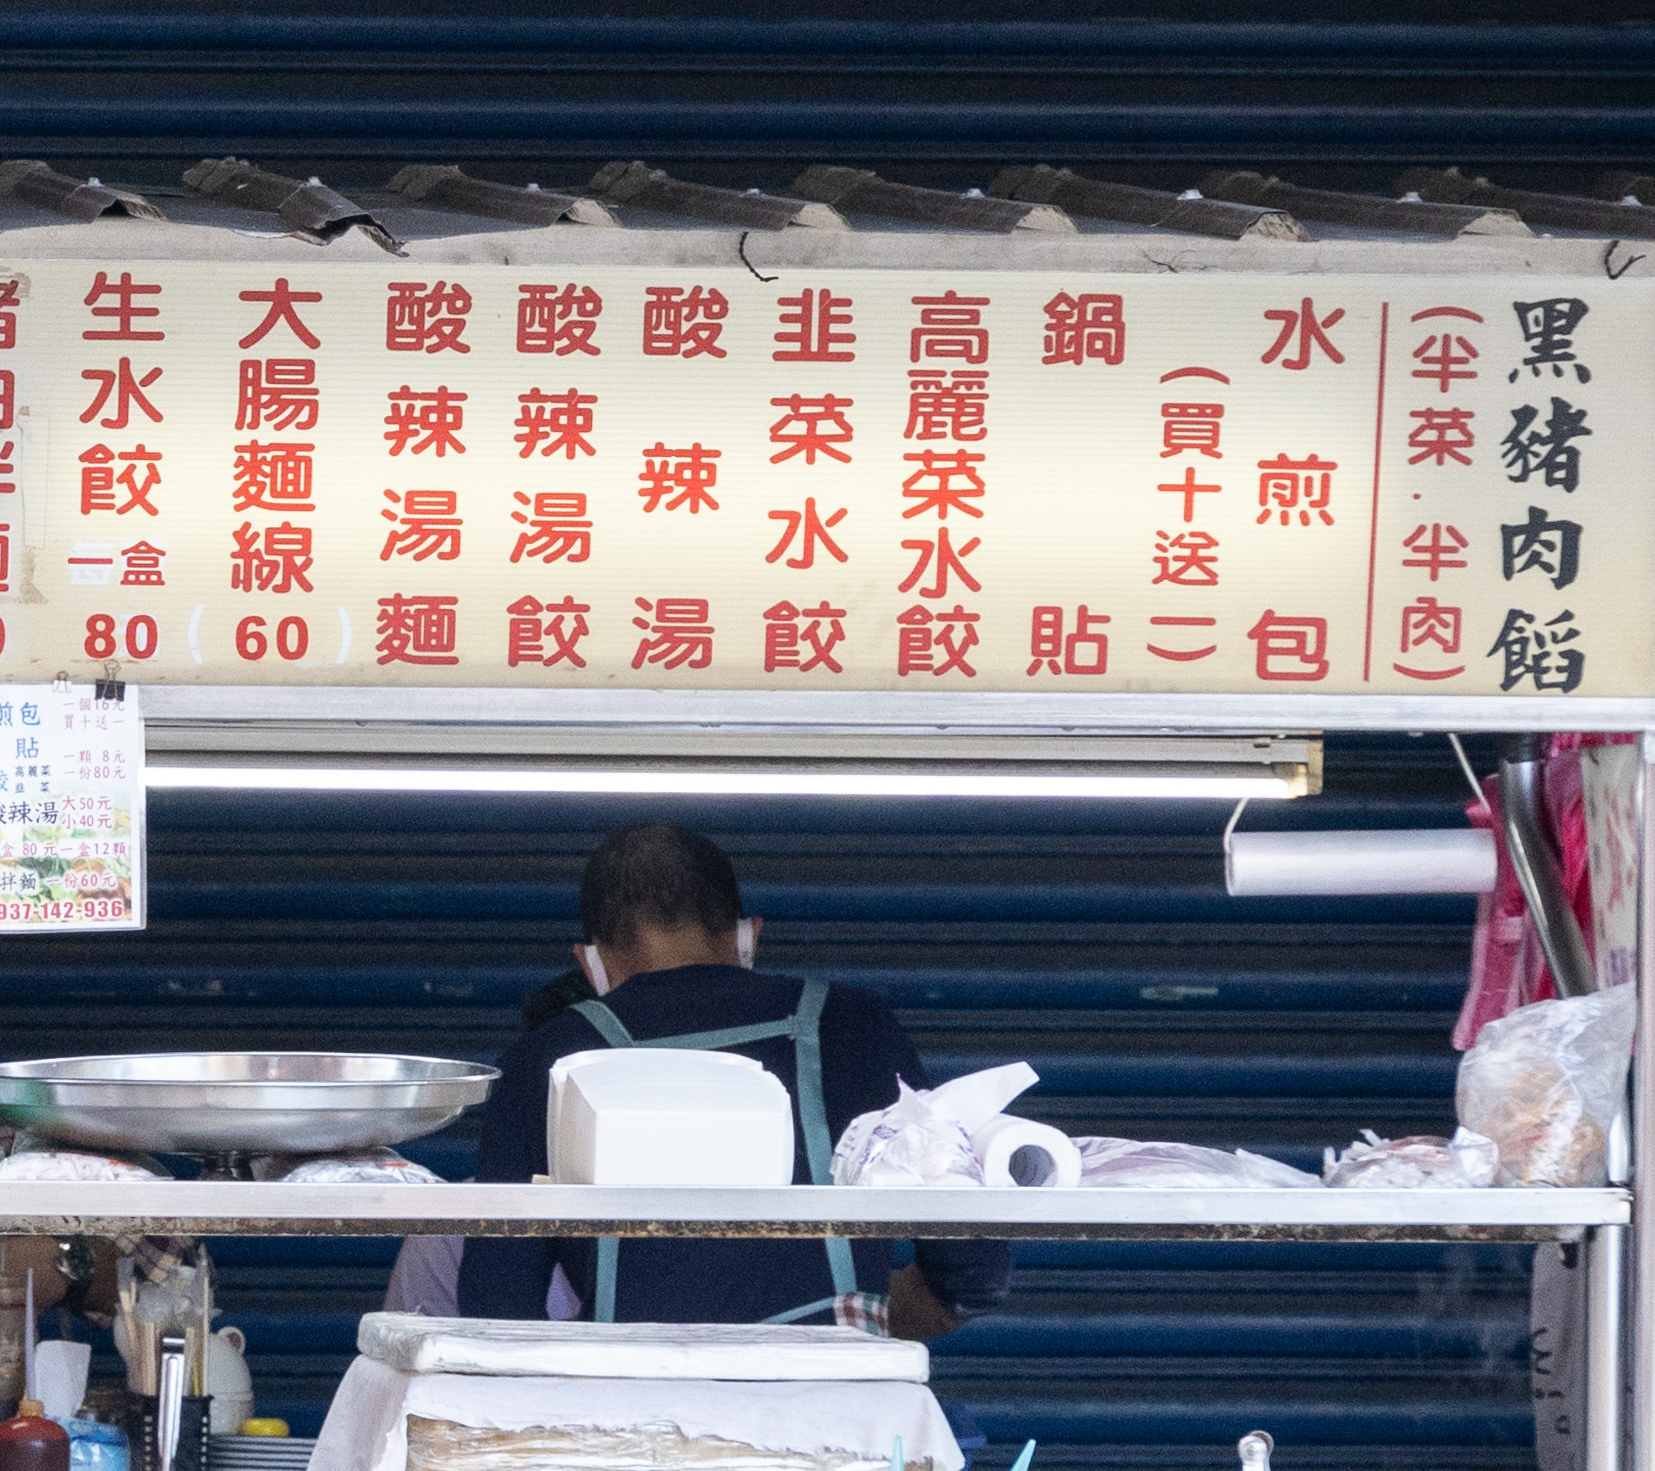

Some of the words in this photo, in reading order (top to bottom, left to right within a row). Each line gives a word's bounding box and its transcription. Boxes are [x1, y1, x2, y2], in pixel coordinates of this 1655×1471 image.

[78, 273, 164, 517] 生水餃
[230, 278, 323, 594] 大腸麵線
[376, 281, 473, 666] 酸辣湯麵
[506, 283, 603, 668] 酸辣湯餃
[631, 285, 729, 670] 酸辣湯
[763, 288, 856, 673] 韭菜水餃
[898, 290, 991, 677] 高麗菜水餃
[1027, 292, 1126, 676] 鍋貼
[1247, 298, 1345, 681] 水煎包
[1488, 298, 1591, 693] 黑豬肉餡
[62, 795, 113, 811] 大50元
[62, 814, 113, 829] 小40元
[84, 613, 158, 659] 80
[235, 615, 309, 661] 60
[45, 873, 117, 889] 一份60元
